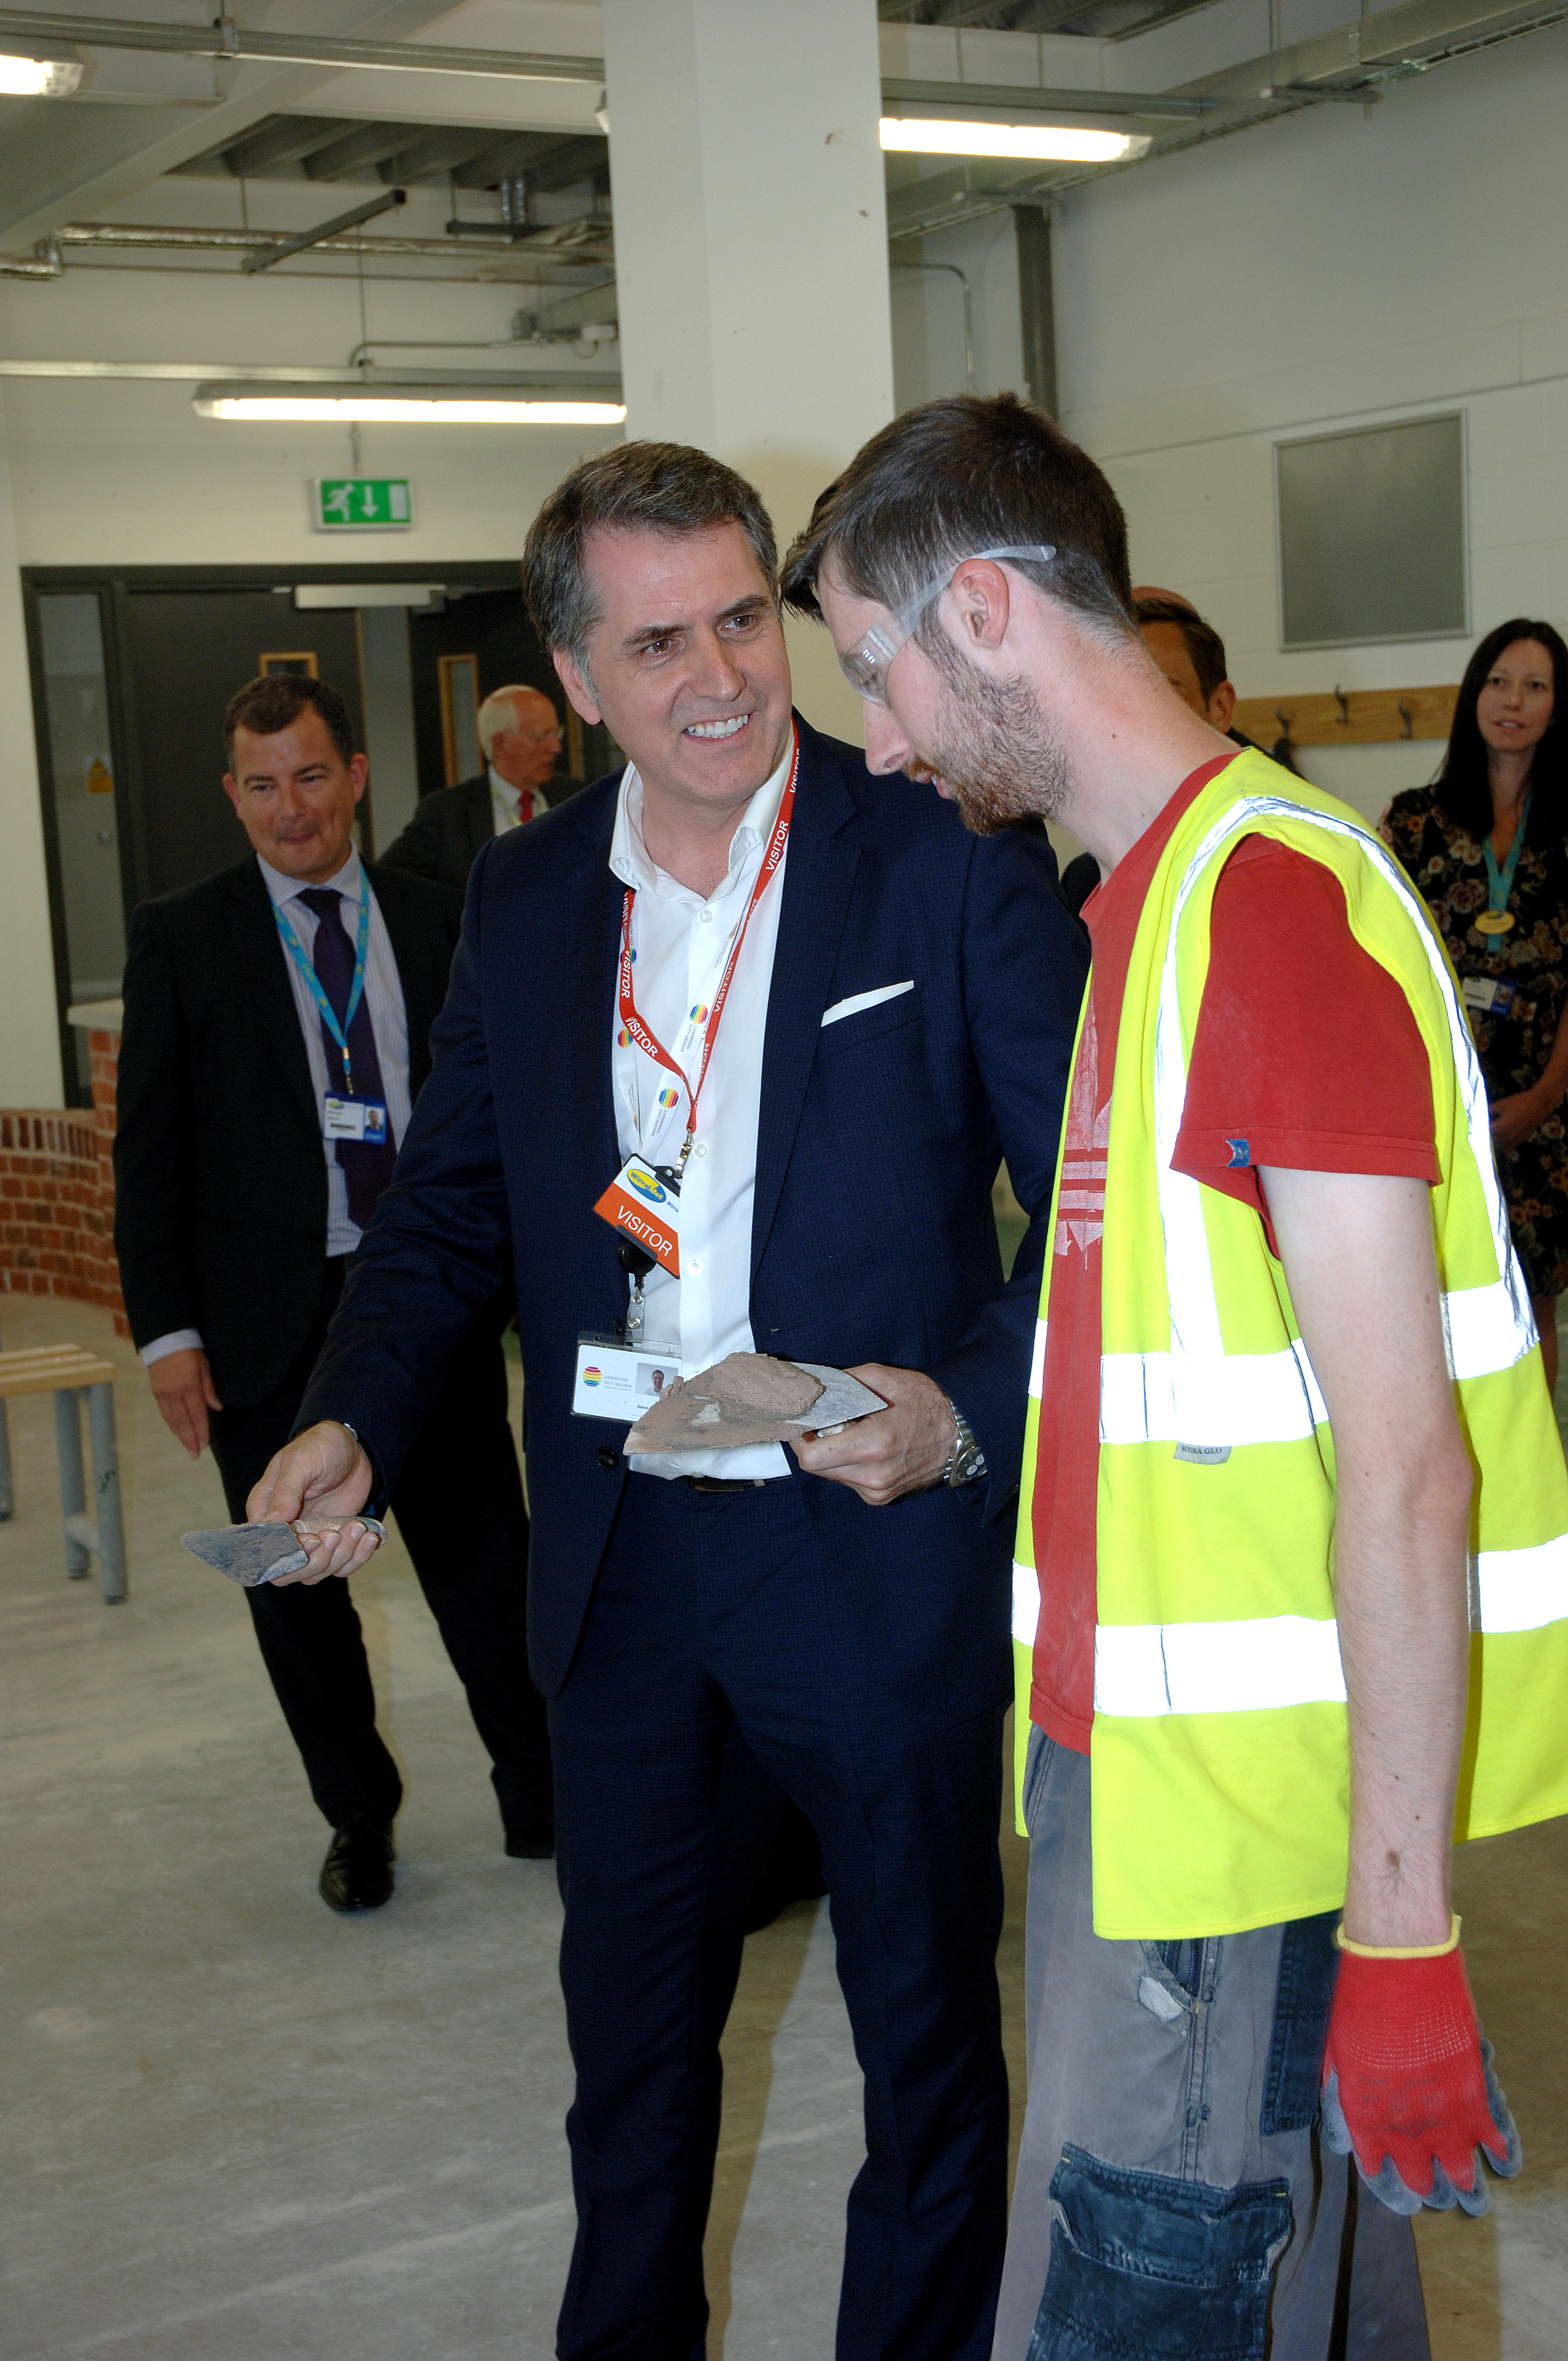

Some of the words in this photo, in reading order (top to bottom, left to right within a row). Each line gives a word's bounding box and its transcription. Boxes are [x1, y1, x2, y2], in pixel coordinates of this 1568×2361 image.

[765, 820, 788, 870] VISITOR
[621, 950, 631, 998] VISITOR
[714, 961, 734, 1013] VISITOR
[625, 1016, 658, 1057] VISITOR
[618, 1205, 672, 1256] VISITOR
